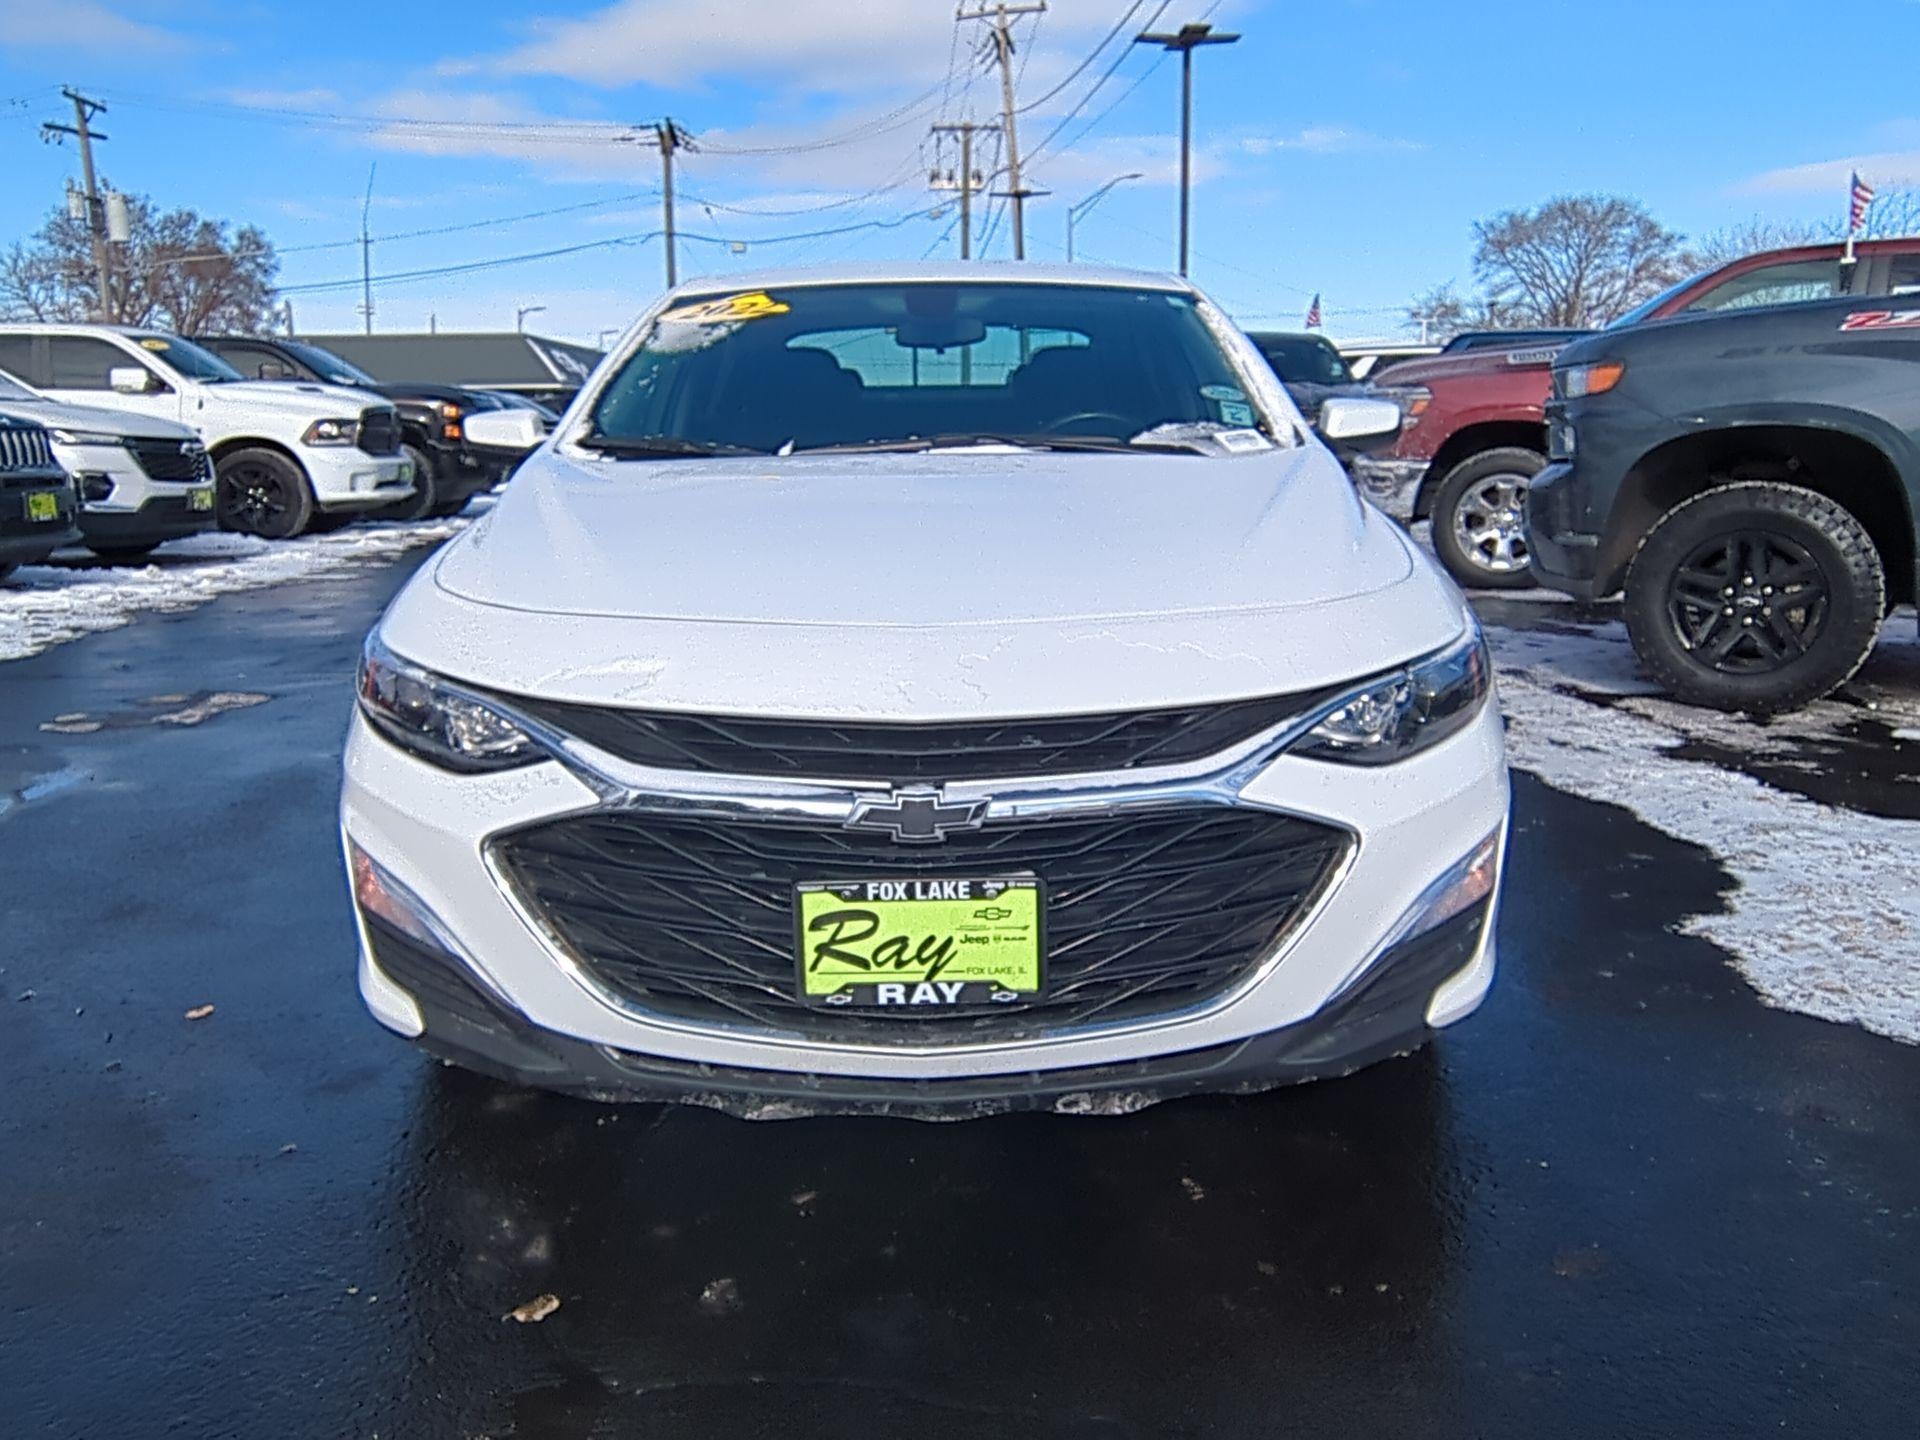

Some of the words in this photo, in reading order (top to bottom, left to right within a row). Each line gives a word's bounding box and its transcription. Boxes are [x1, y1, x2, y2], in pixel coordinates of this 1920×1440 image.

[866, 882, 908, 900] FOX
[915, 881, 971, 900] LAKE
[808, 909, 958, 982] Ray
[960, 934, 990, 945] Jeep
[966, 967, 985, 975] FOX
[877, 982, 965, 1005] RAY
